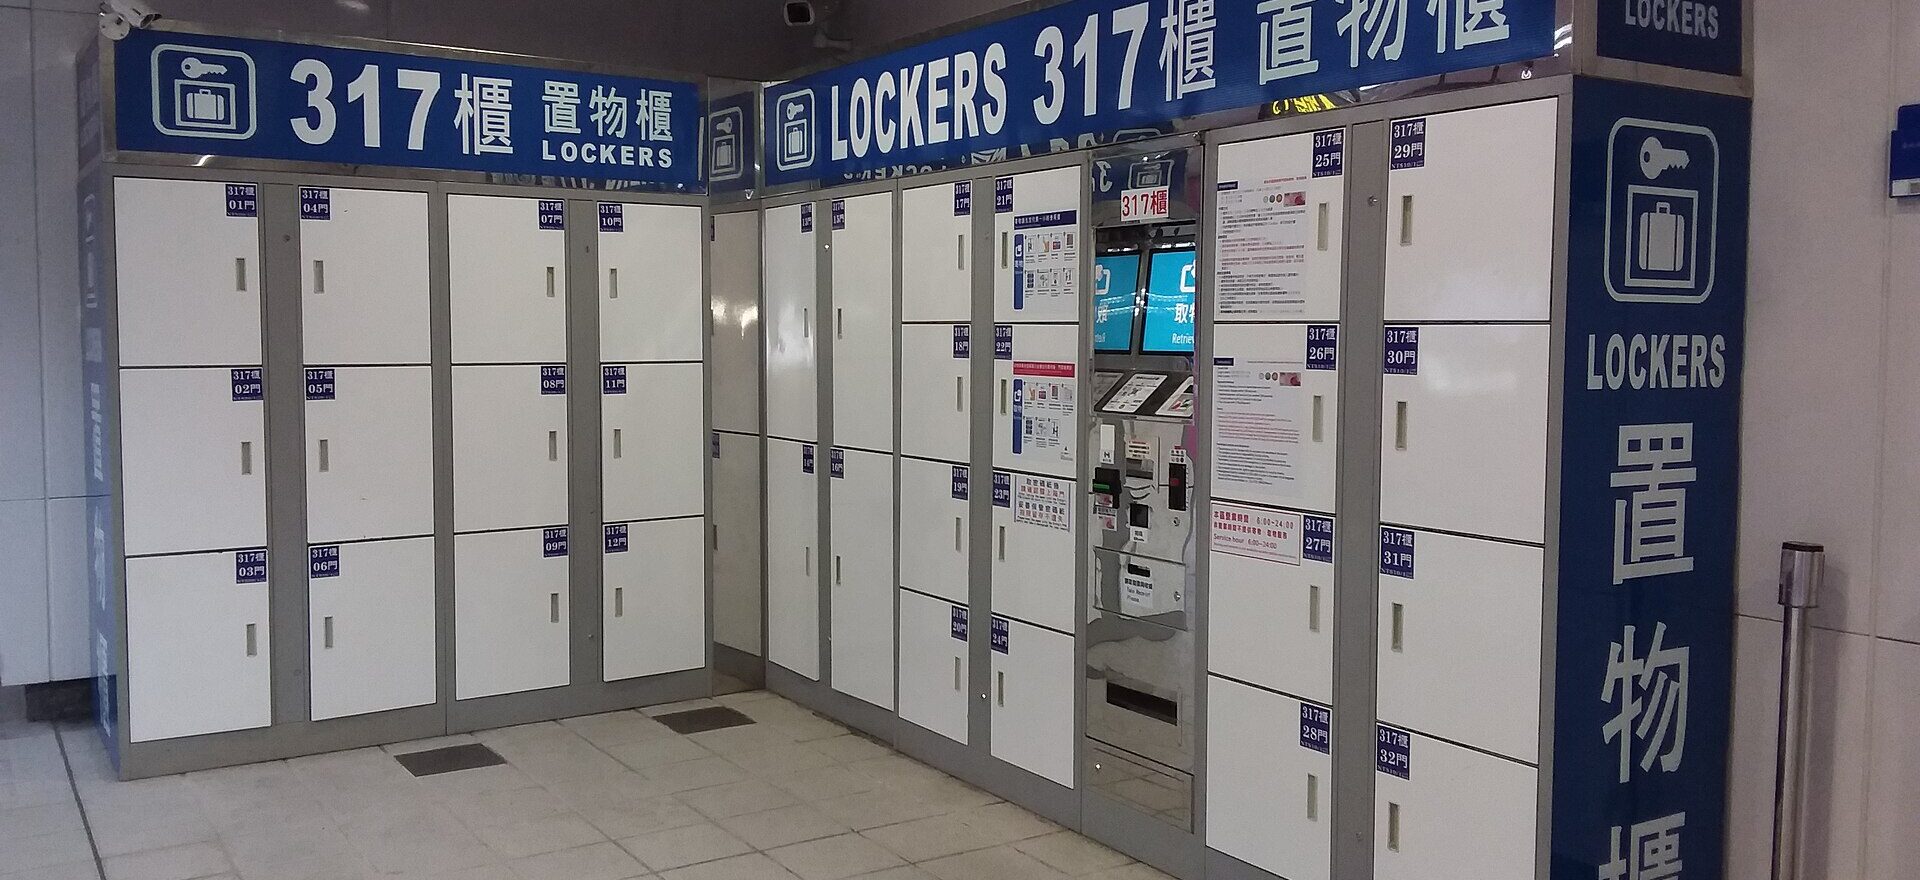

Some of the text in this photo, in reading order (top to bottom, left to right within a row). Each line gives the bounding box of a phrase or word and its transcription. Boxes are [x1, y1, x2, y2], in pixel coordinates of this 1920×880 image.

[1625, 0, 1719, 39] LOCKERS
[831, 42, 1007, 161] LOCKERS
[1033, 0, 1217, 125] 317櫃
[289, 58, 674, 156] 317櫃 置物櫃
[1394, 122, 1424, 138] 317櫃
[1315, 132, 1342, 148] 317櫃
[541, 139, 673, 168] LOCKERS
[1394, 142, 1423, 159] 29門
[1316, 152, 1342, 167] 25門
[230, 200, 255, 210] 01門
[304, 204, 328, 213] 04門
[1122, 189, 1168, 217] 317櫃
[542, 215, 562, 224] 07門
[602, 218, 621, 226] 10門
[1309, 328, 1336, 340] 317櫃
[1387, 330, 1417, 344] 317櫃
[1310, 346, 1335, 360] 26門
[1387, 350, 1416, 364] 30門
[1587, 333, 1726, 390] LOCKERS
[234, 384, 260, 394] 02門
[308, 384, 333, 393] 05門
[543, 380, 564, 389] 08門
[606, 380, 626, 388] 11門
[1305, 518, 1331, 534] 317櫃
[608, 538, 626, 547] 12門
[1306, 538, 1330, 553] 27門
[1383, 530, 1412, 546] 317櫃
[546, 541, 567, 551] 09門
[313, 561, 338, 572] 06門
[1384, 550, 1412, 568] 31門
[239, 566, 264, 577] 03門
[1302, 706, 1329, 724] 317櫃
[1303, 725, 1328, 744] 28門
[1379, 728, 1408, 748] 317櫃
[1380, 748, 1408, 768] 32門
